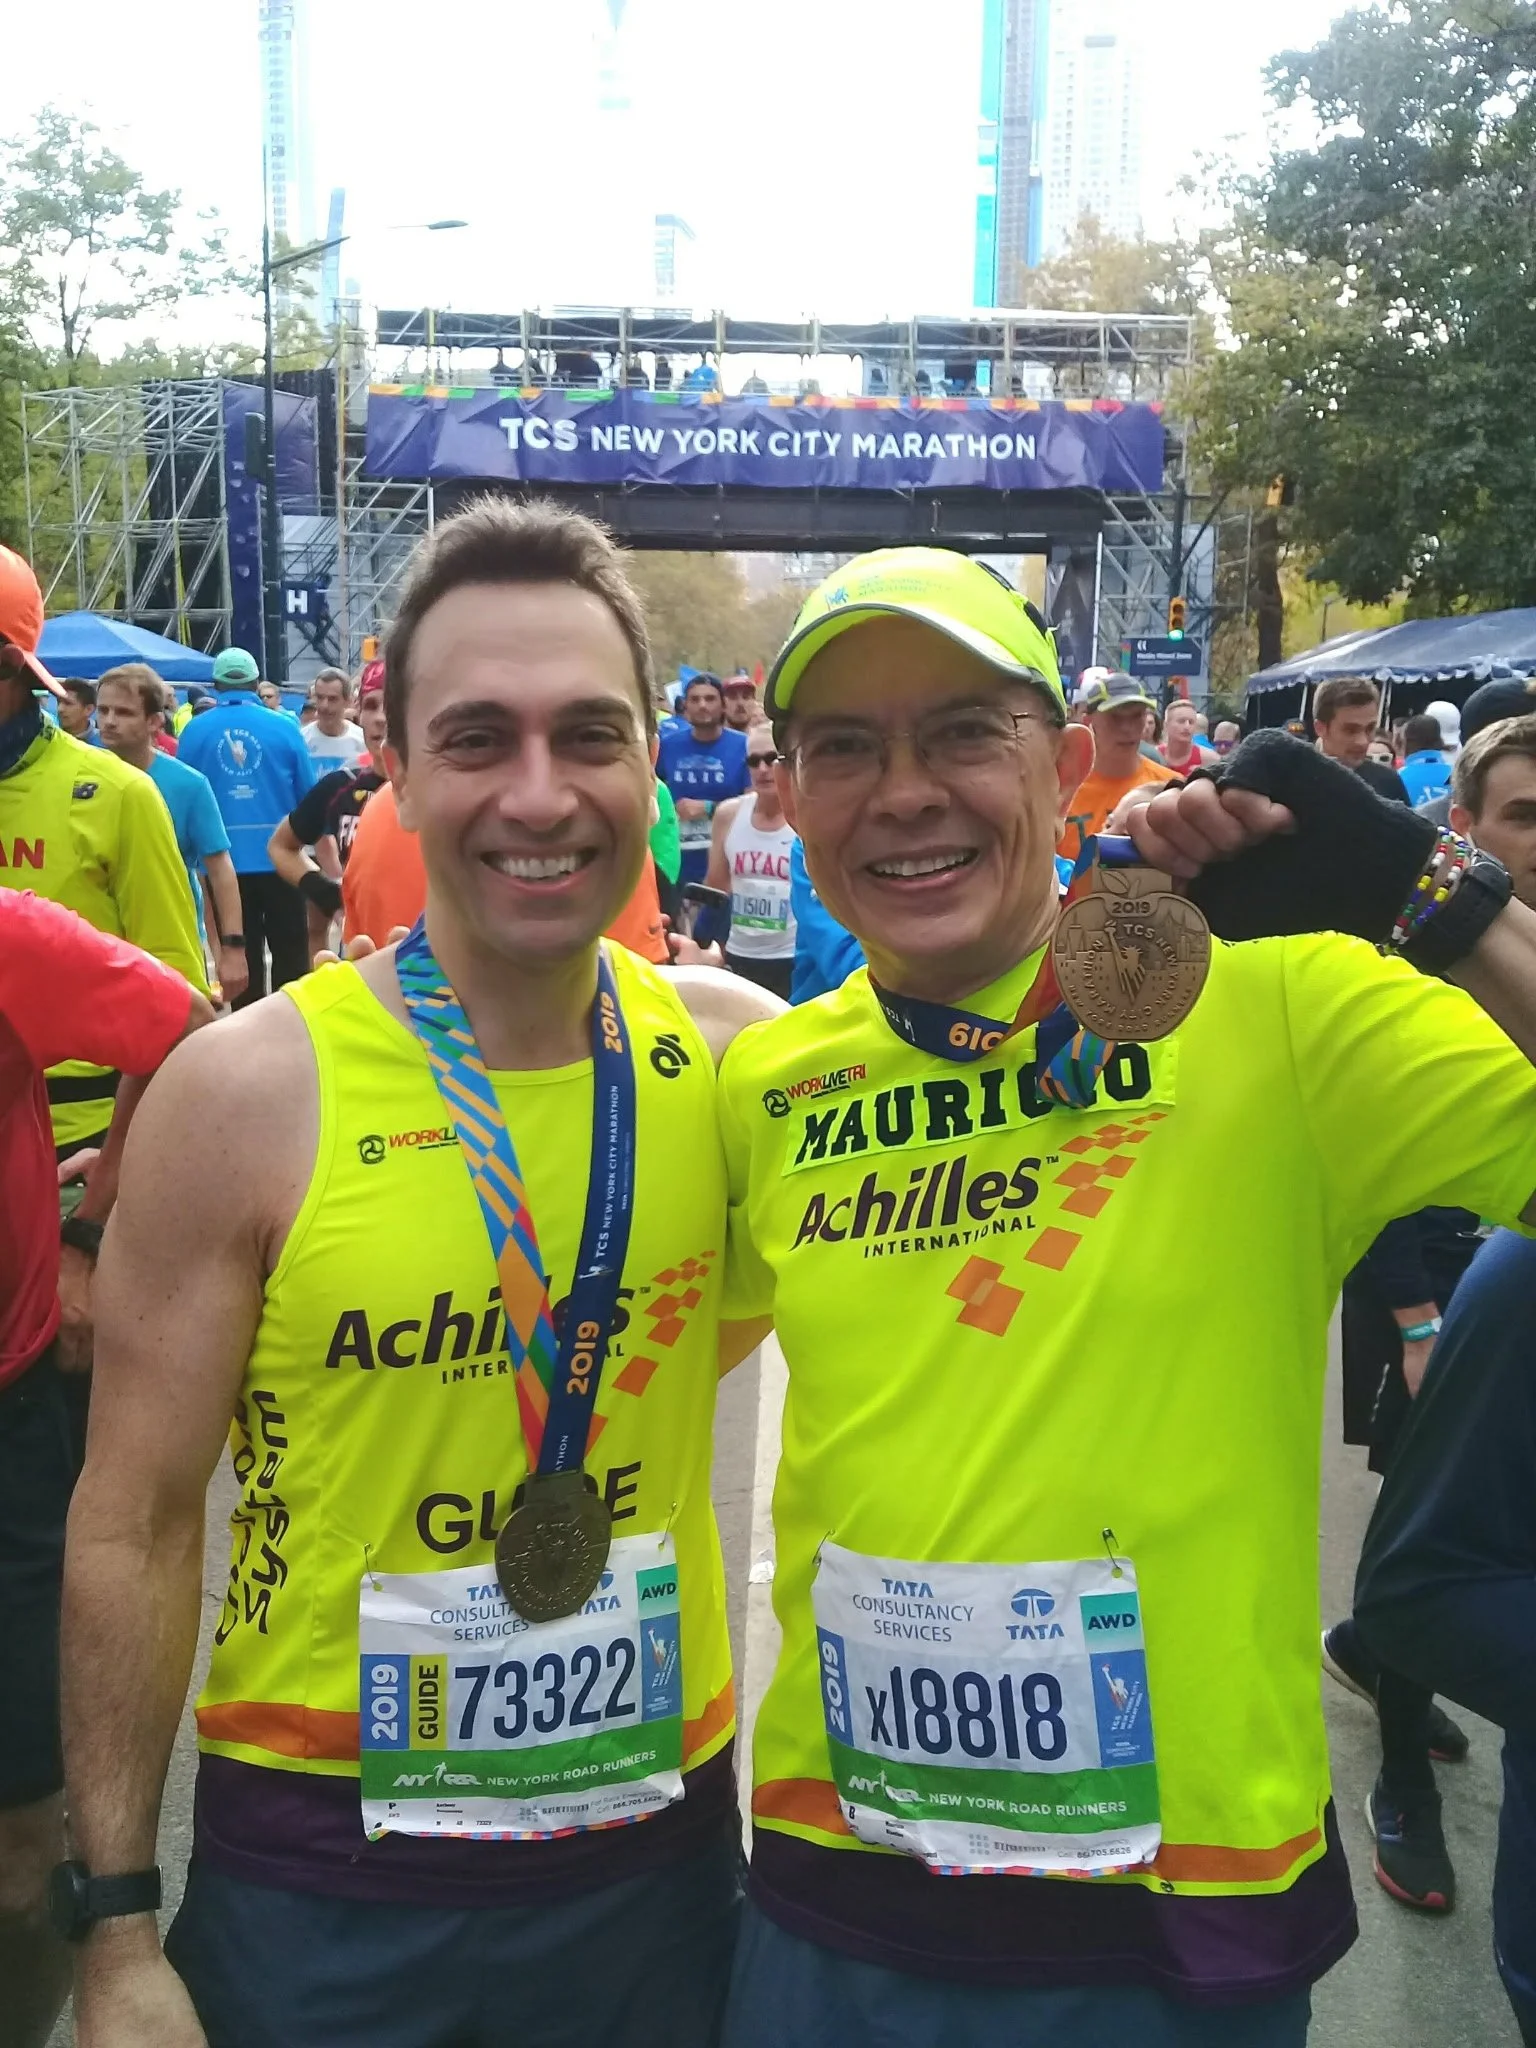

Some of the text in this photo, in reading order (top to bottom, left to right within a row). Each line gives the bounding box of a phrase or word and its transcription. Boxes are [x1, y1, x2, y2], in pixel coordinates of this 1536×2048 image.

[500, 416, 1037, 460] TCS NEW YORK CITY MARATHON
[286, 589, 308, 614] H
[735, 851, 789, 881] NYAC
[1111, 901, 1151, 915] 2019
[1124, 923, 1156, 939] TCS
[600, 991, 623, 1054] 2019
[595, 1085, 619, 1260] TCS NEW YORK CITY MARATHON
[790, 1154, 1041, 1251] Achilles
[864, 1215, 1037, 1259] INTERNATIONAL
[566, 1320, 600, 1396] 2019
[641, 1582, 676, 1601] AWD
[881, 1578, 934, 1599] TATA
[852, 1594, 974, 1622] CONSULTANCY
[1087, 1612, 1137, 1631] AWD
[454, 1619, 529, 1641] SERVICES
[873, 1619, 952, 1642] SERVICES
[1005, 1624, 1065, 1641] TATA
[371, 1664, 399, 1741] 2019
[418, 1664, 439, 1740] GUIDE
[455, 1637, 636, 1740] 73322
[821, 1640, 846, 1733] 2019
[866, 1665, 1068, 1761] x18818
[487, 1776, 518, 1786] NEW
[522, 1772, 560, 1786] YORK
[563, 1764, 599, 1781] ROAD
[602, 1750, 657, 1773] RUNNERS
[928, 1793, 962, 1808] NEW
[966, 1796, 1005, 1812] YORK
[1009, 1801, 1051, 1816] ROAD
[1055, 1800, 1127, 1816] RUNNERS
